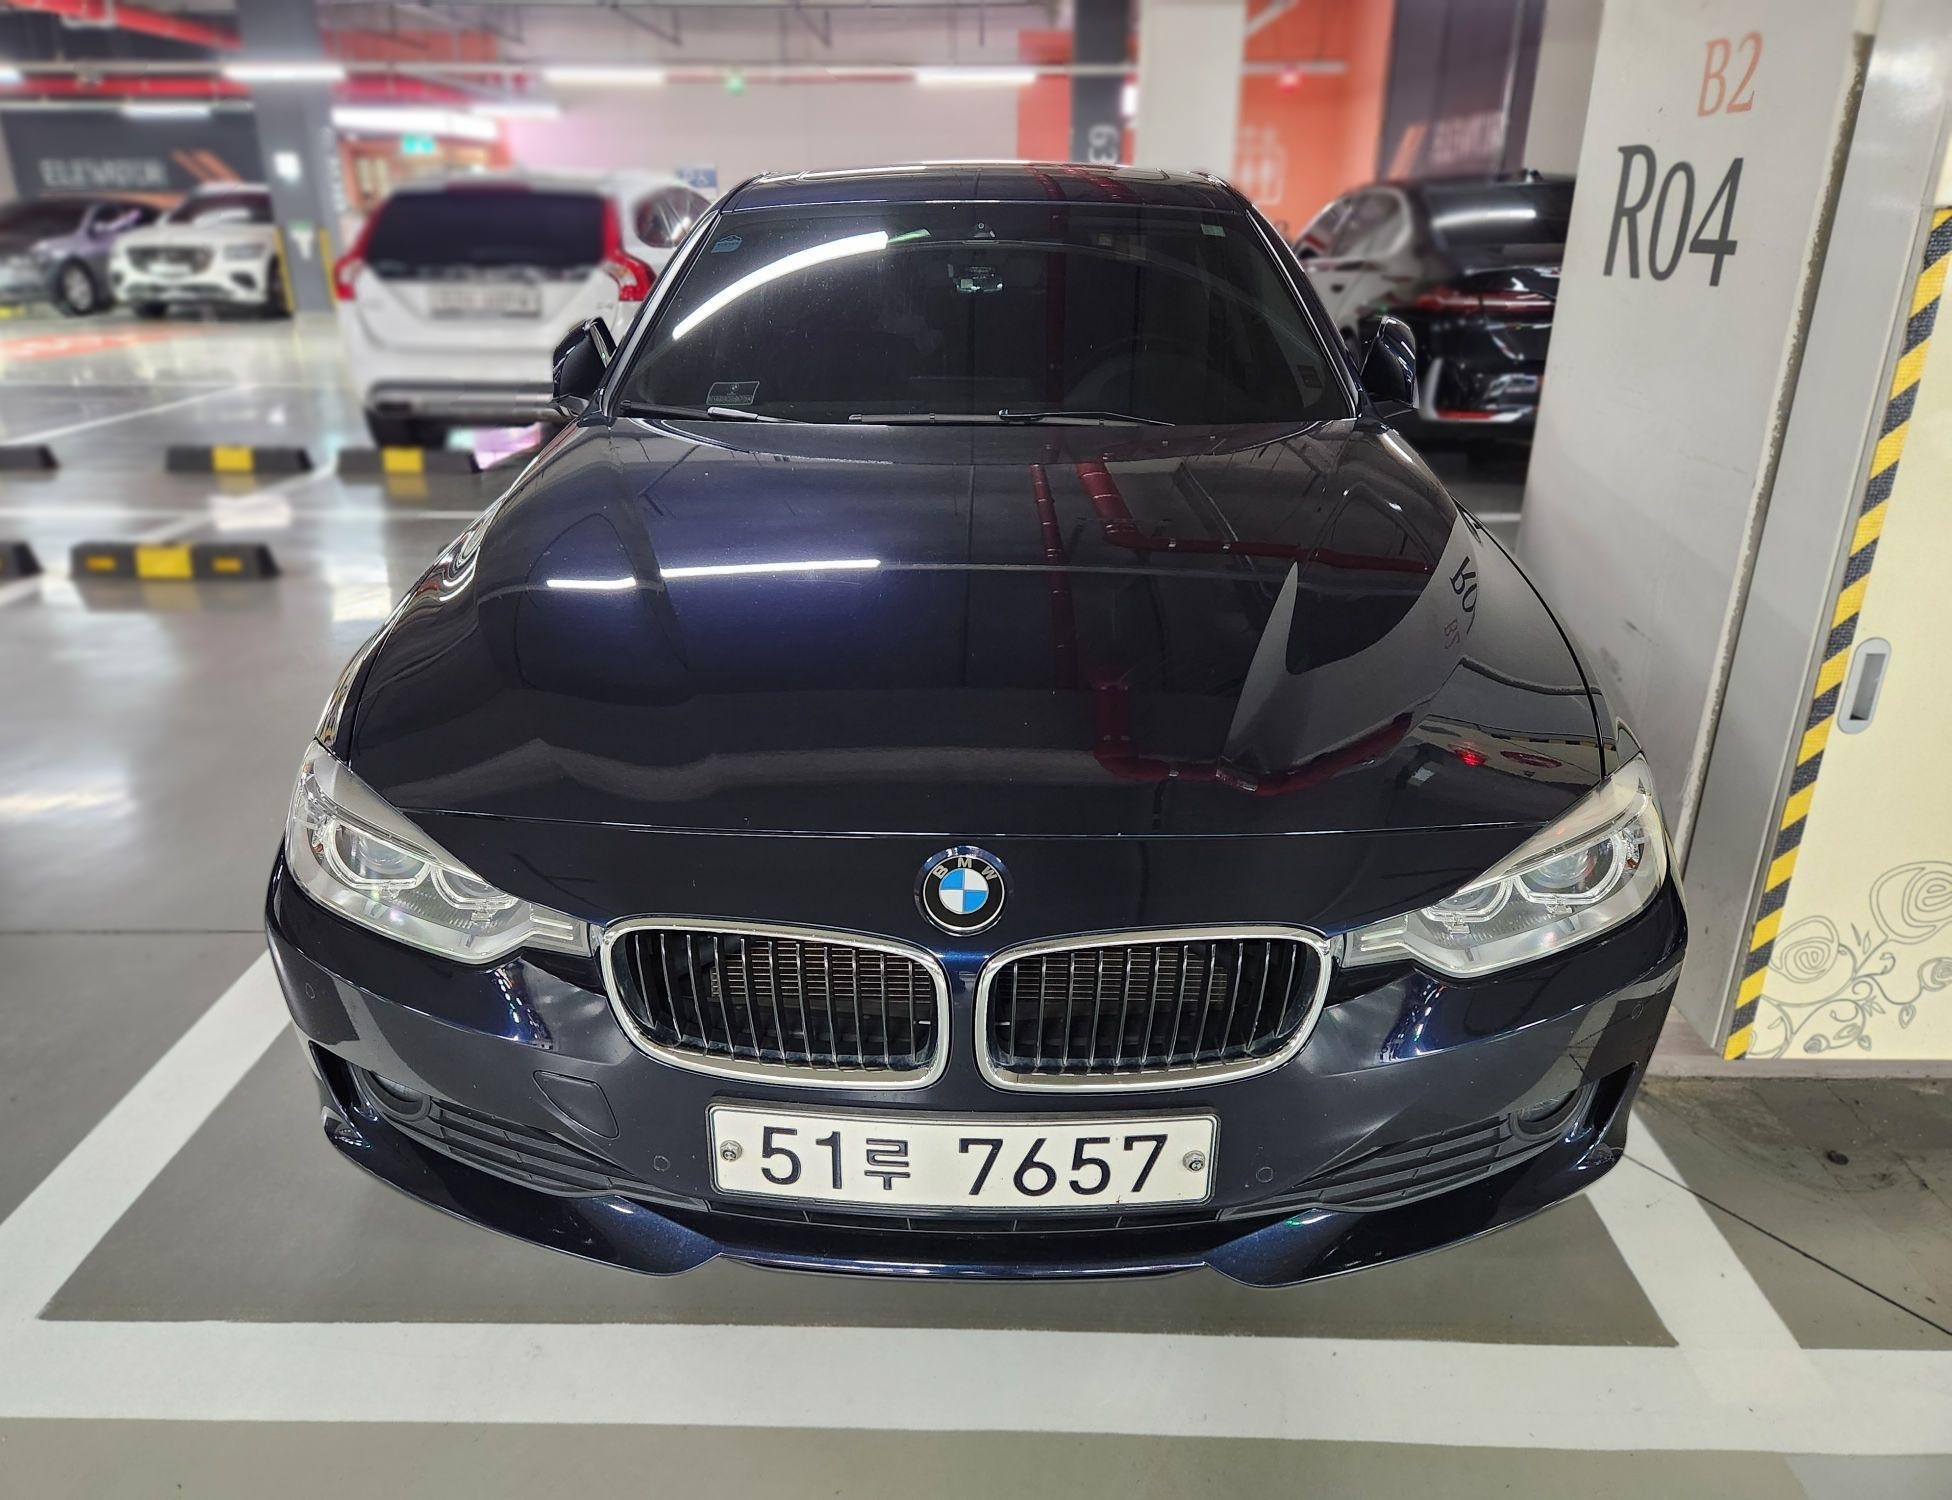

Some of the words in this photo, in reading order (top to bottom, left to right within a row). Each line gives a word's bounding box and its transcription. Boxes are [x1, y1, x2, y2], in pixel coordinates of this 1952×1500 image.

[1697, 31, 1763, 117] B2
[1603, 144, 1744, 287] R04
[932, 857, 998, 881] BMW
[761, 1125, 911, 1191] 51루
[958, 1133, 1169, 1197] 7657
